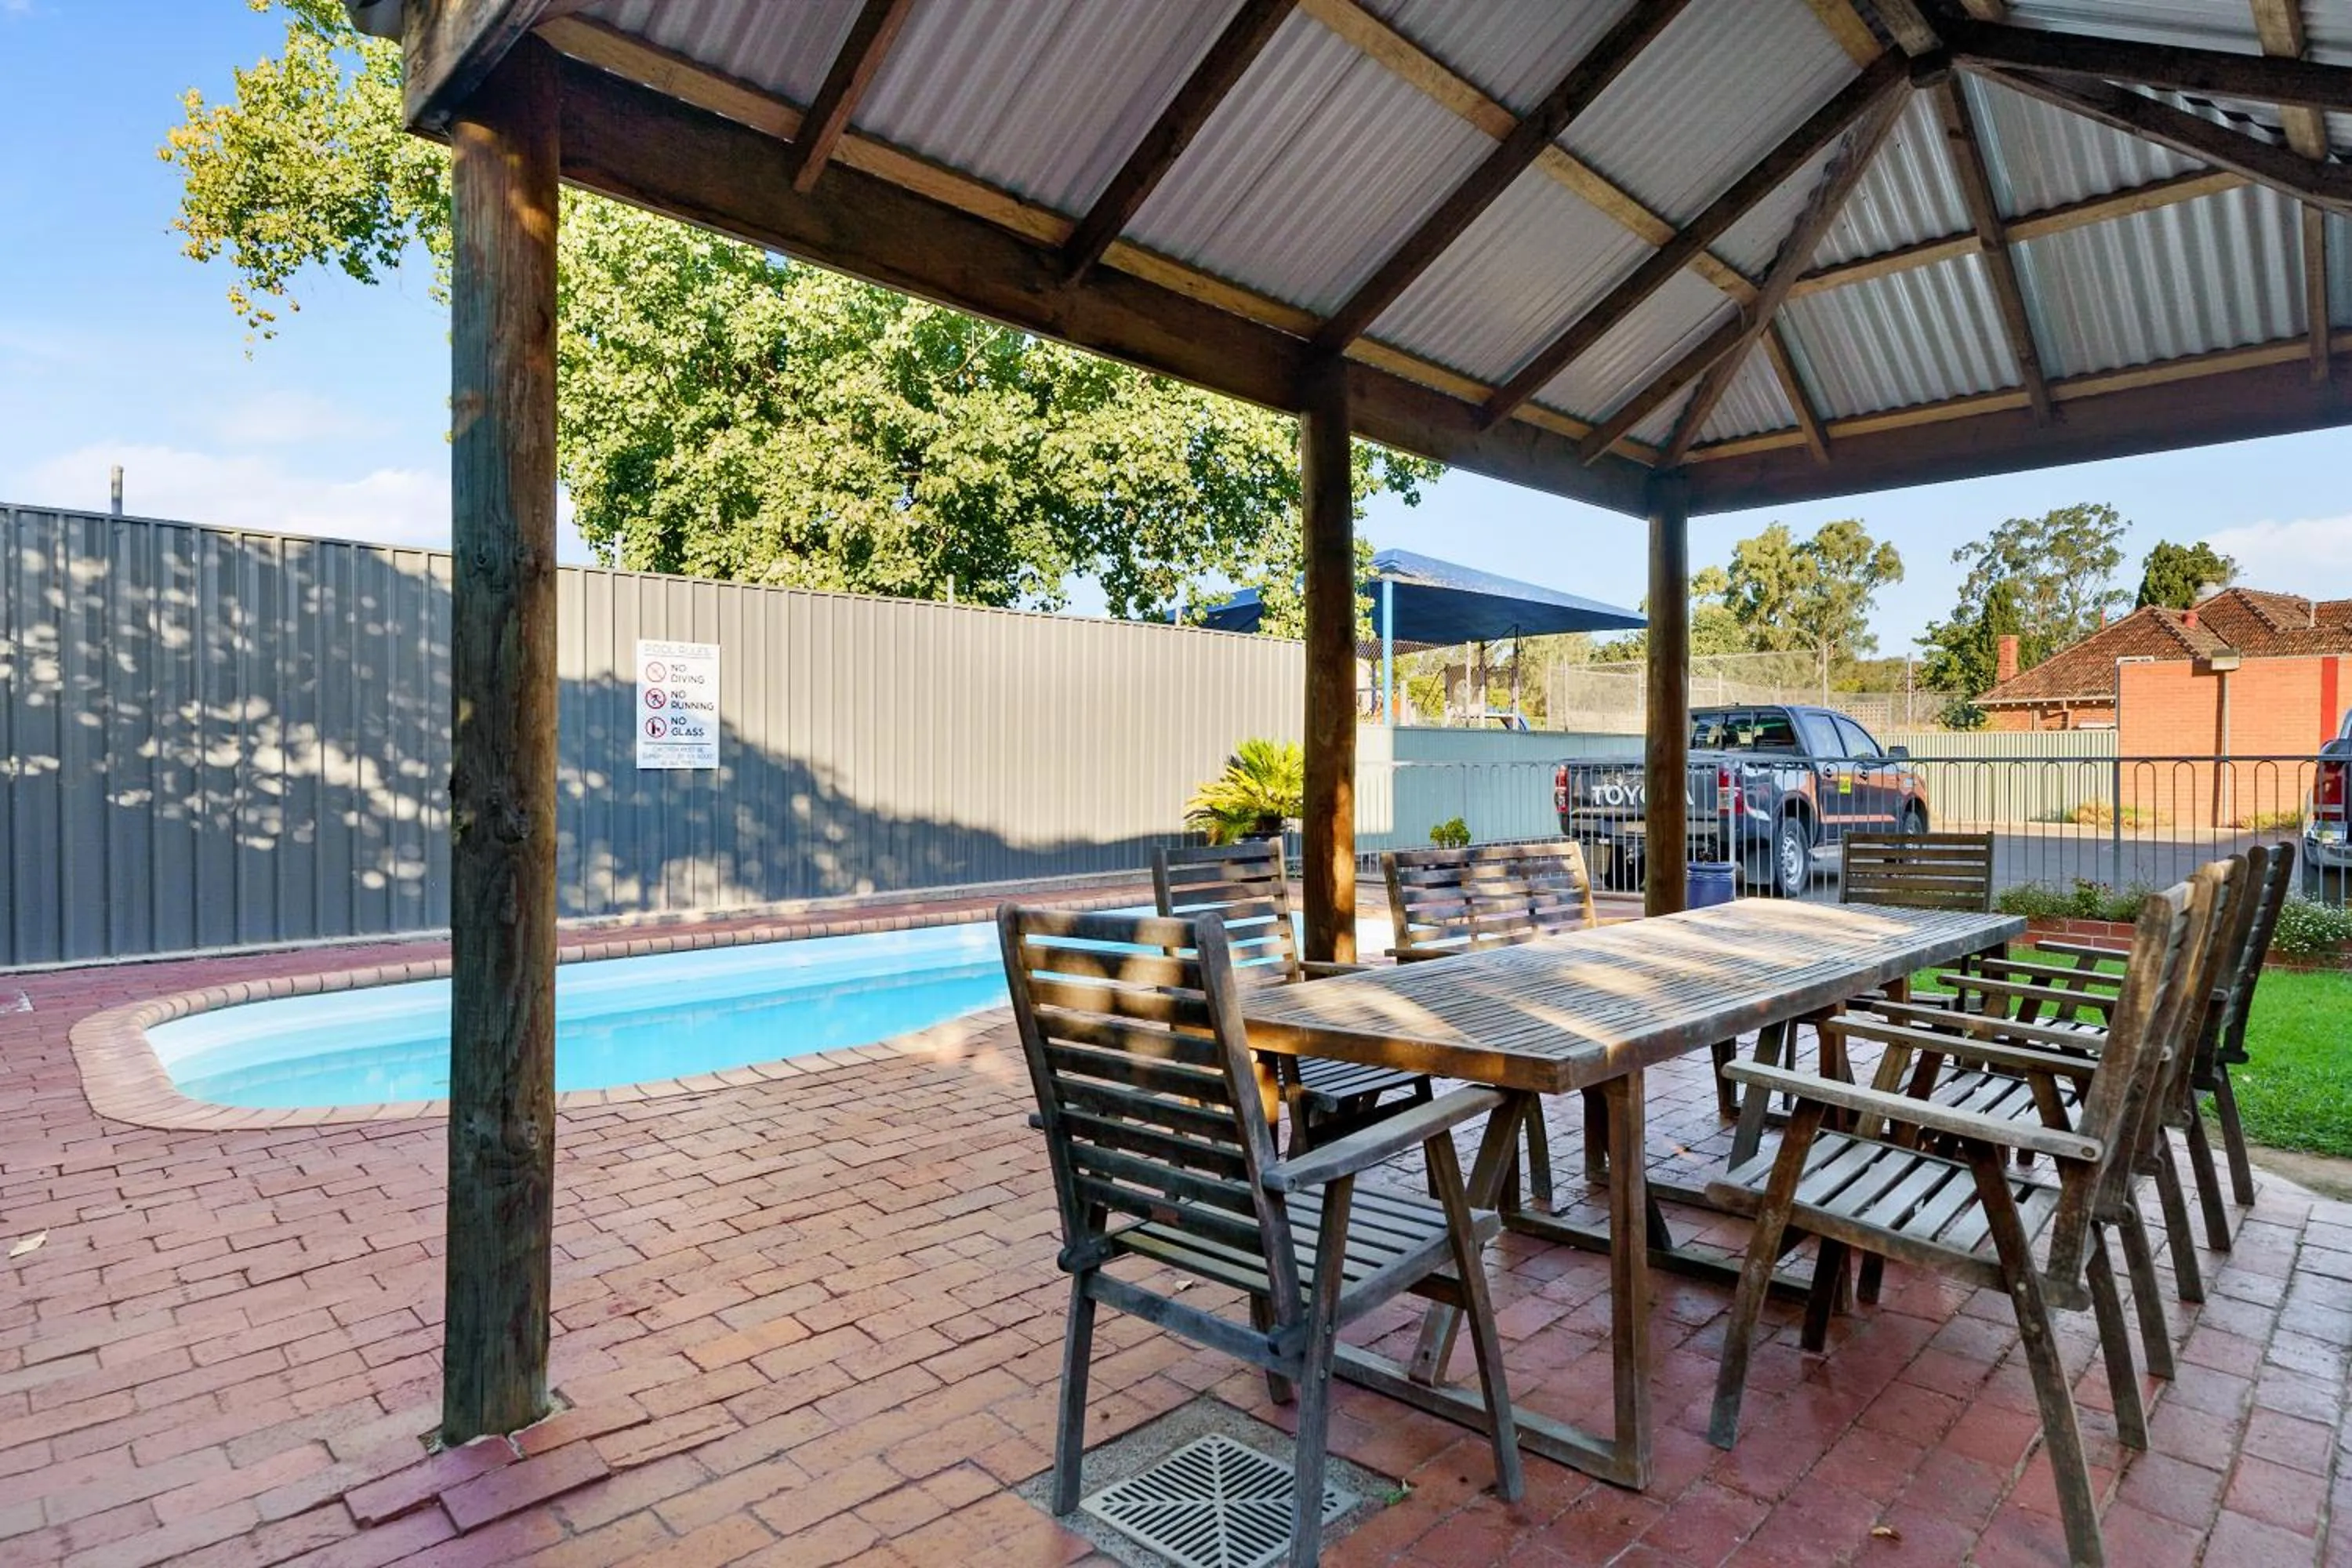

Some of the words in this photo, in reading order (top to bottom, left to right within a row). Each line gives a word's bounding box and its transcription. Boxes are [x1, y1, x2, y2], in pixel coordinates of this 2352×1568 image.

[670, 664, 687, 673] NO
[670, 673, 705, 684] DIVING
[670, 690, 687, 699] NO
[670, 701, 714, 711] RUNNING
[670, 716, 687, 725] NO
[670, 727, 705, 737] GLASS
